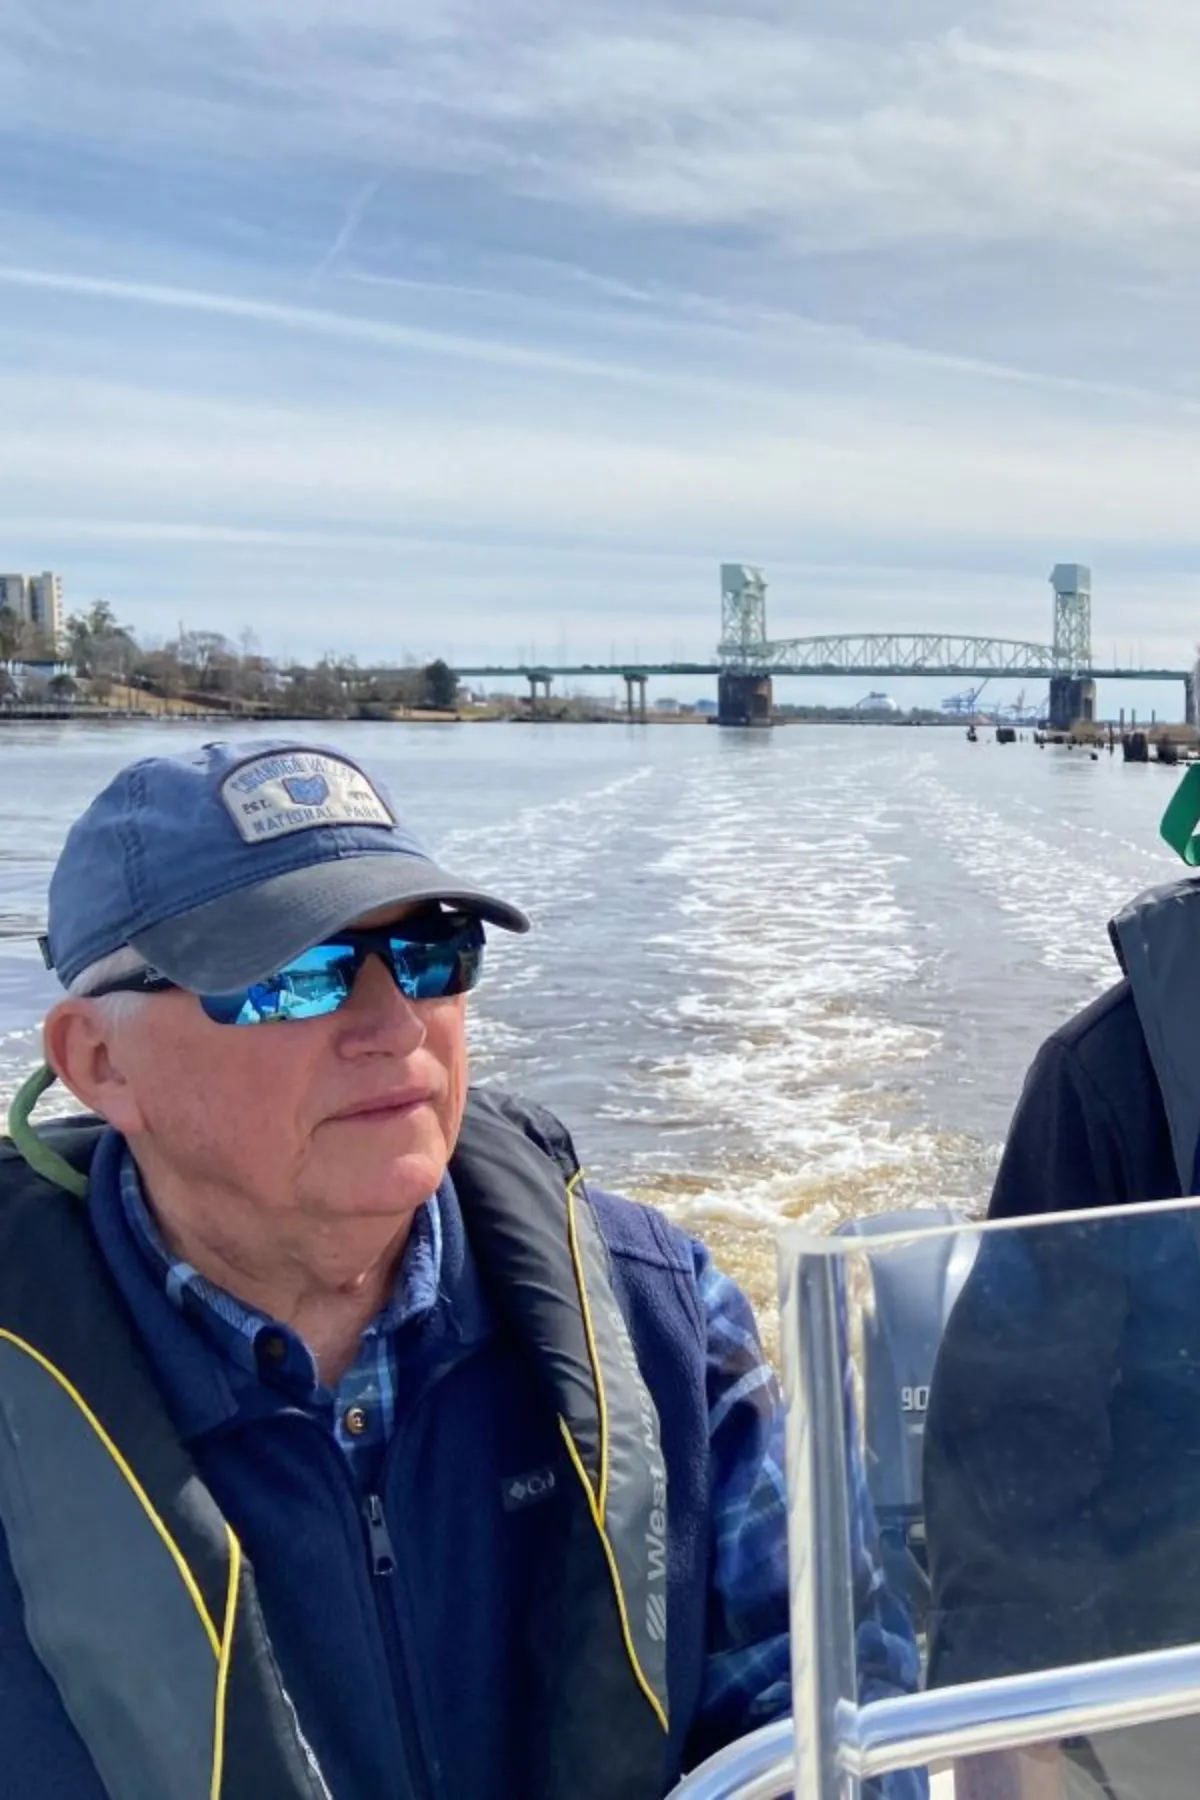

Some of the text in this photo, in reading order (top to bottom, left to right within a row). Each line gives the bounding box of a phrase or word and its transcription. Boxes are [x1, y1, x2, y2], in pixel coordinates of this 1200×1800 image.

[252, 805, 382, 835] NATIONAL PARK
[901, 1386, 930, 1411] 90
[645, 1465, 667, 1581] West
